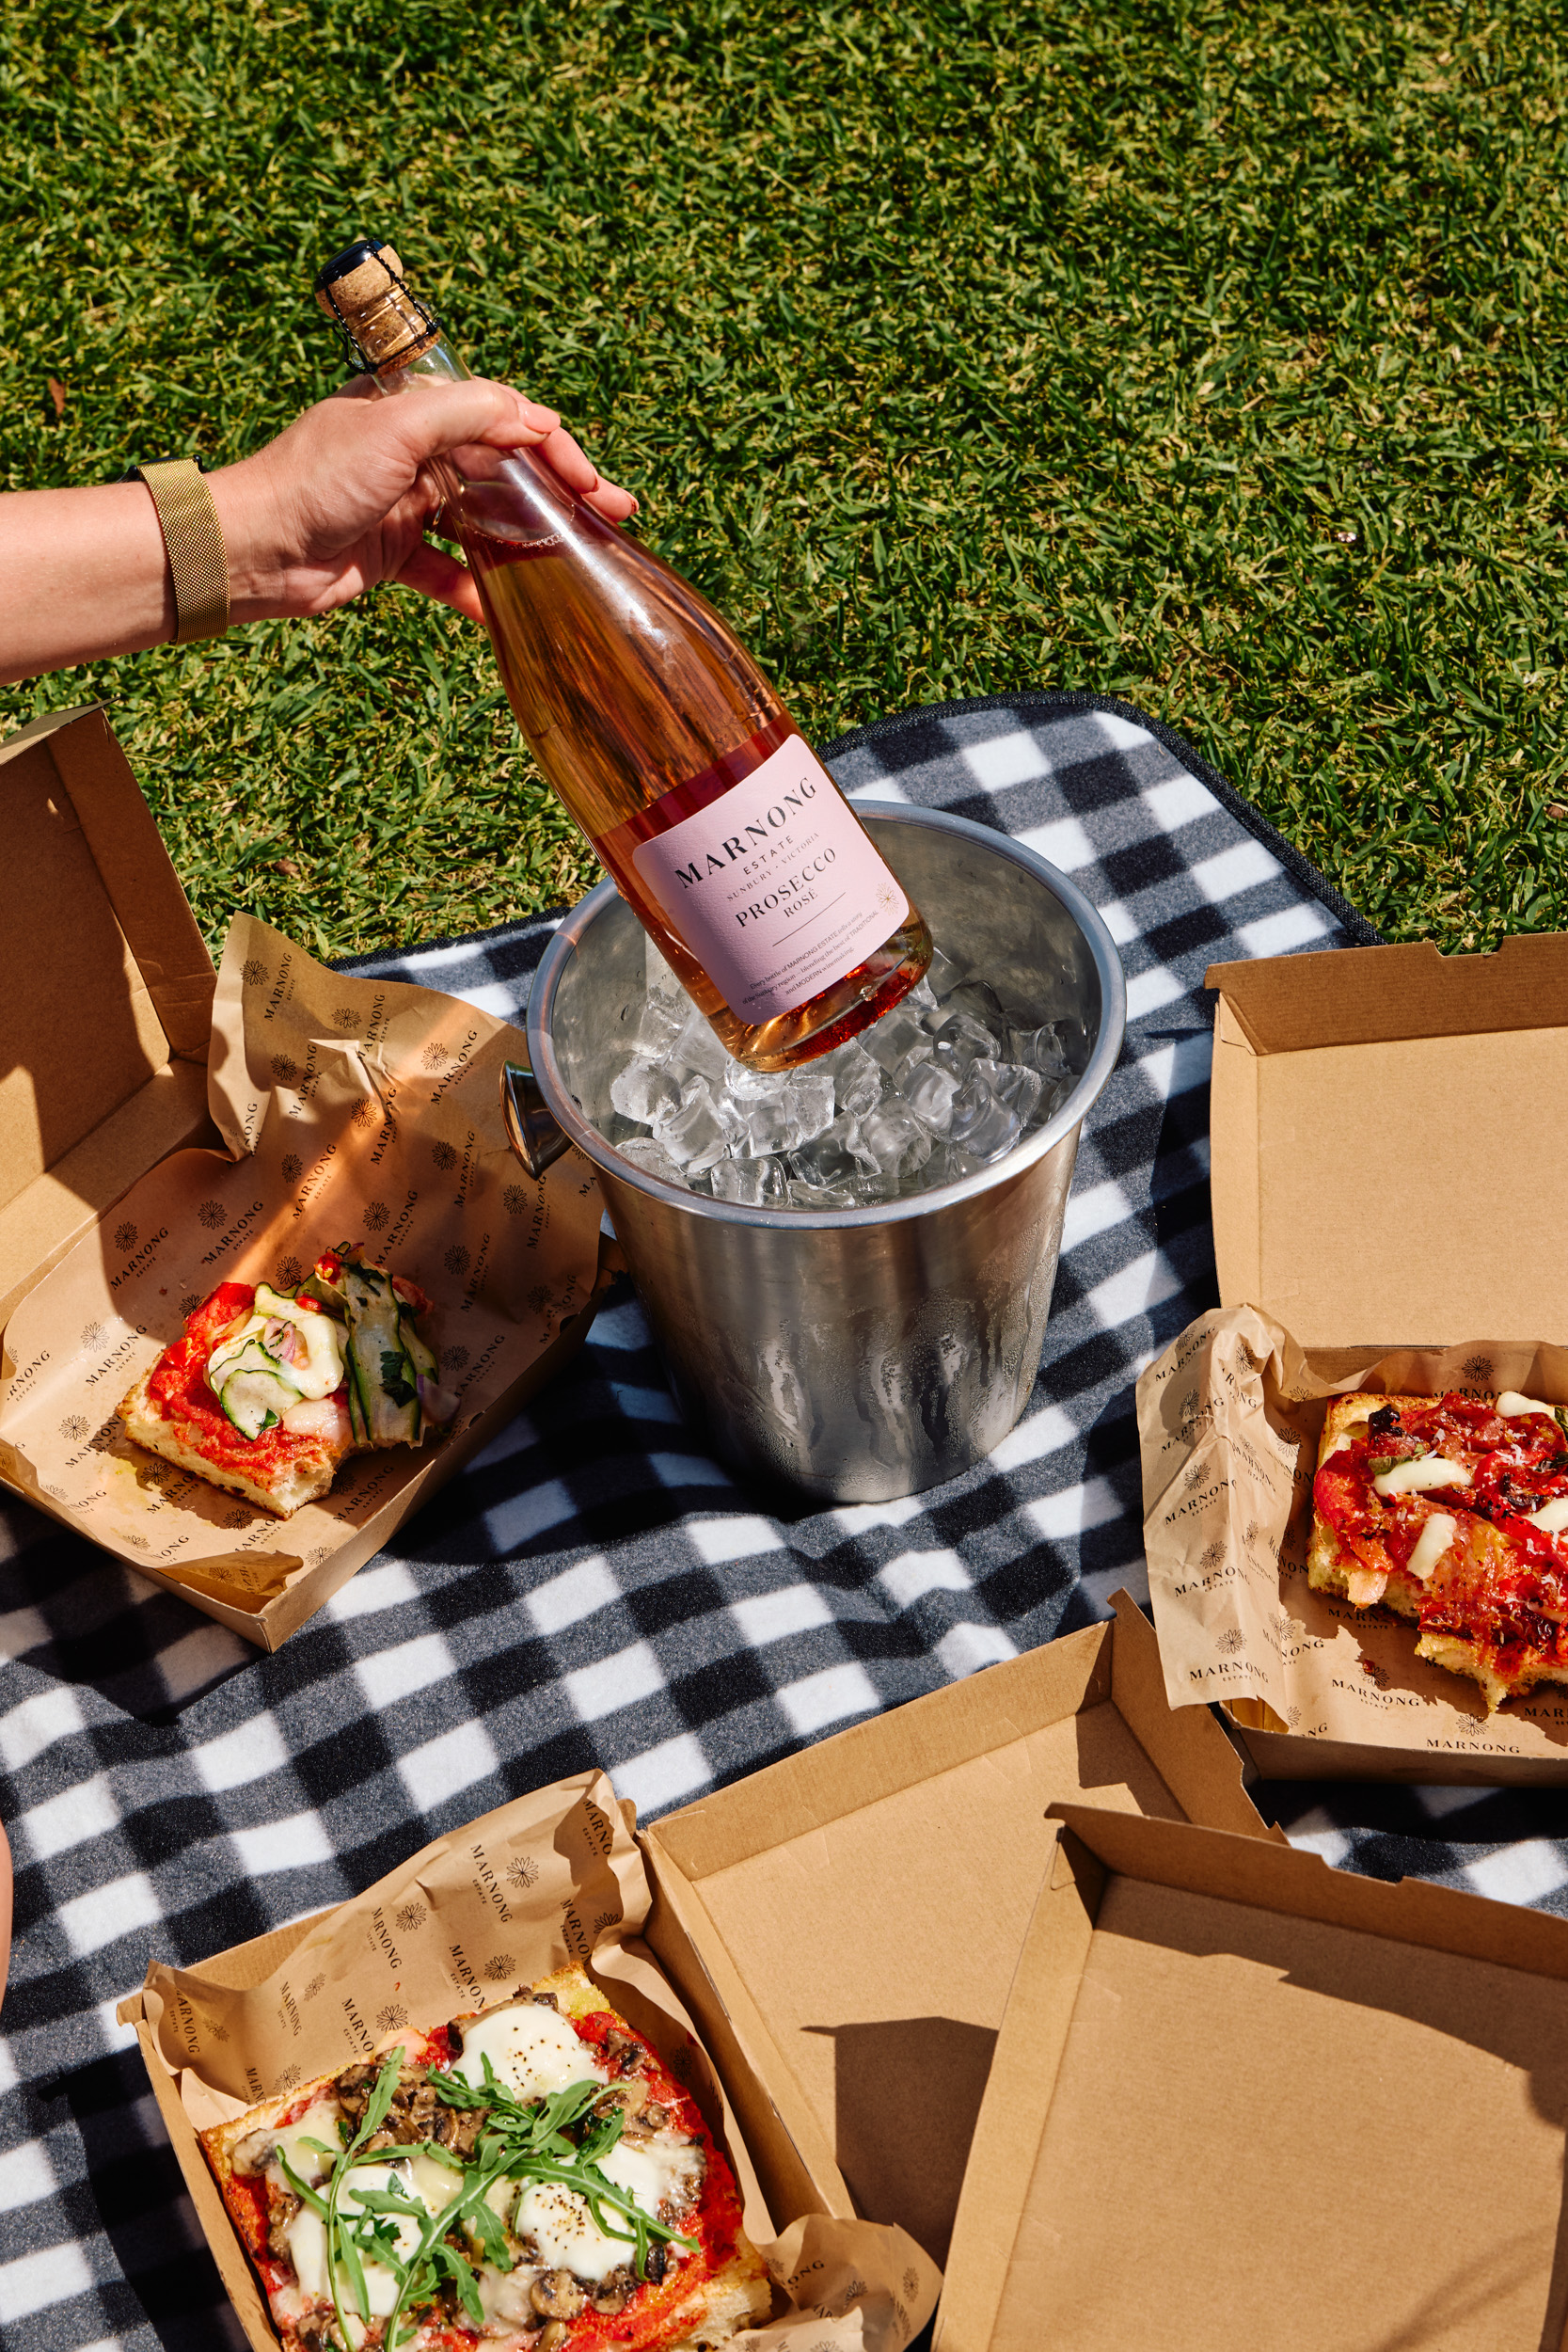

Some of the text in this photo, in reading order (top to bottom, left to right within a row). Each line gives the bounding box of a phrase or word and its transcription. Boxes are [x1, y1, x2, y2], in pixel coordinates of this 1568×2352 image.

[674, 777, 816, 889] MARNONG
[743, 835, 794, 875] ESTATE
[727, 833, 819, 901] SUNBURY VICTORIA
[736, 848, 835, 927] PROSECCO
[784, 887, 818, 917] ROSÉ
[750, 978, 766, 989] Every
[765, 970, 782, 981] bottle
[782, 964, 789, 973] of
[787, 946, 818, 969] MARNONG
[817, 930, 839, 949] ESTATE
[778, 974, 797, 987] region
[800, 955, 826, 973] blending
[825, 948, 833, 958] the
[832, 941, 845, 952] best
[849, 910, 879, 937] TRADITIONAL
[264, 952, 293, 1022] MARNONG
[785, 985, 797, 994] and
[796, 969, 822, 989] MODERN
[289, 1043, 317, 1119] MARNONG
[431, 1029, 478, 1105] MARNONG
[371, 1088, 397, 1166] MARNNG
[293, 1143, 337, 1220] MARNONG
[453, 1131, 475, 1208] MARNONG
[203, 1200, 264, 1264] MARNONG
[374, 1190, 418, 1267] MARNONG
[527, 1175, 547, 1250] MARNONG
[110, 1227, 169, 1291] MARNONG
[461, 1232, 490, 1312] MARNONG
[8, 1349, 52, 1401] RNONG
[85, 1324, 148, 1387] MARNONG
[1155, 1326, 1216, 1382] MARNONG
[147, 1470, 196, 1514] MARNO
[333, 1465, 394, 1523] MARNONG
[1328, 1608, 1380, 1623] MARN
[1189, 1661, 1269, 1683] MARNONG
[1332, 1679, 1419, 1707] MARNONG
[1427, 1739, 1520, 1754] MARNONG
[583, 1799, 613, 1855] MARNO
[470, 1844, 514, 1923] MARNONG
[472, 1879, 487, 1905] ESTATE
[372, 1907, 402, 1969] MRNONG
[561, 1899, 593, 1967] MARNON
[449, 1945, 487, 2009] MARNON
[451, 1973, 467, 1998] ESTATE
[279, 1981, 302, 2036] MARNONG
[341, 1998, 374, 2053] MARNO
[343, 2028, 358, 2054] ESTATE
[245, 2067, 267, 2106] MARNO
